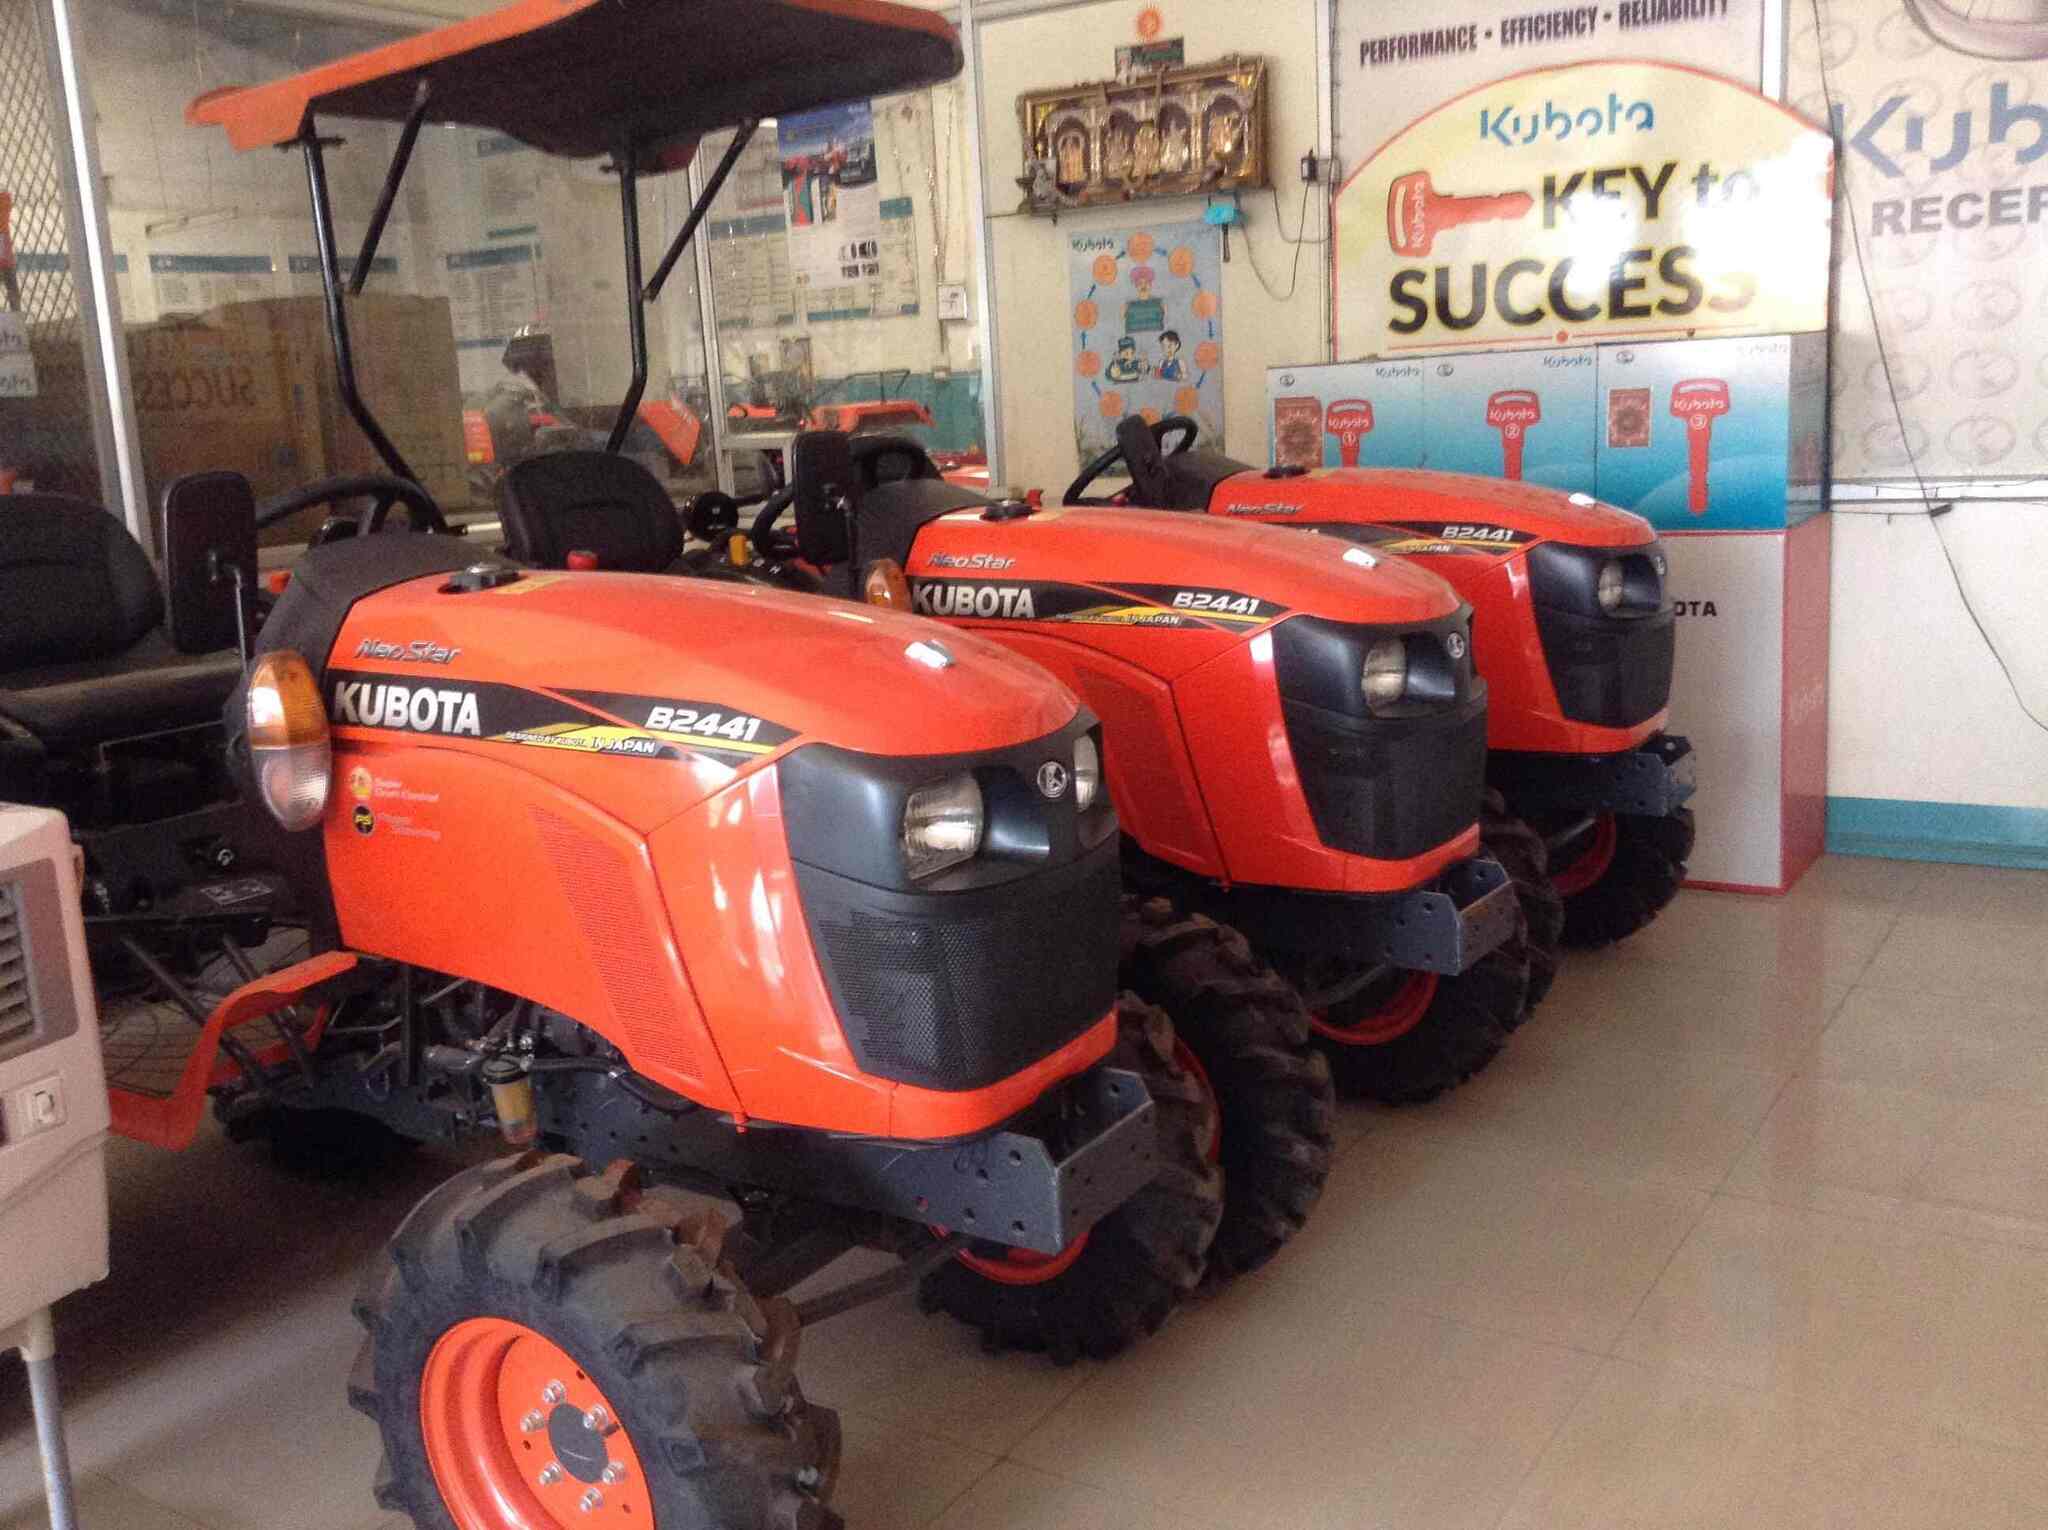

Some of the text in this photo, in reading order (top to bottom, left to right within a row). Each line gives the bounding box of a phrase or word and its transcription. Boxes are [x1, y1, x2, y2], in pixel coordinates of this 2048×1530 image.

[1360, 0, 1729, 67] PERFORMANCE EFFICIENCY RELIABILITY
[1479, 92, 1655, 147] Kubota
[1543, 162, 1678, 229] KEY
[1488, 407, 1537, 422] Kubota
[1673, 400, 1727, 412] Kubota
[1441, 526, 1514, 541] B2441
[911, 583, 1037, 618] KUBOTA
[1173, 592, 1259, 615] B2441
[335, 681, 481, 737] KUBOTA
[645, 706, 761, 742] B2441
[604, 737, 656, 754] JAPAN
